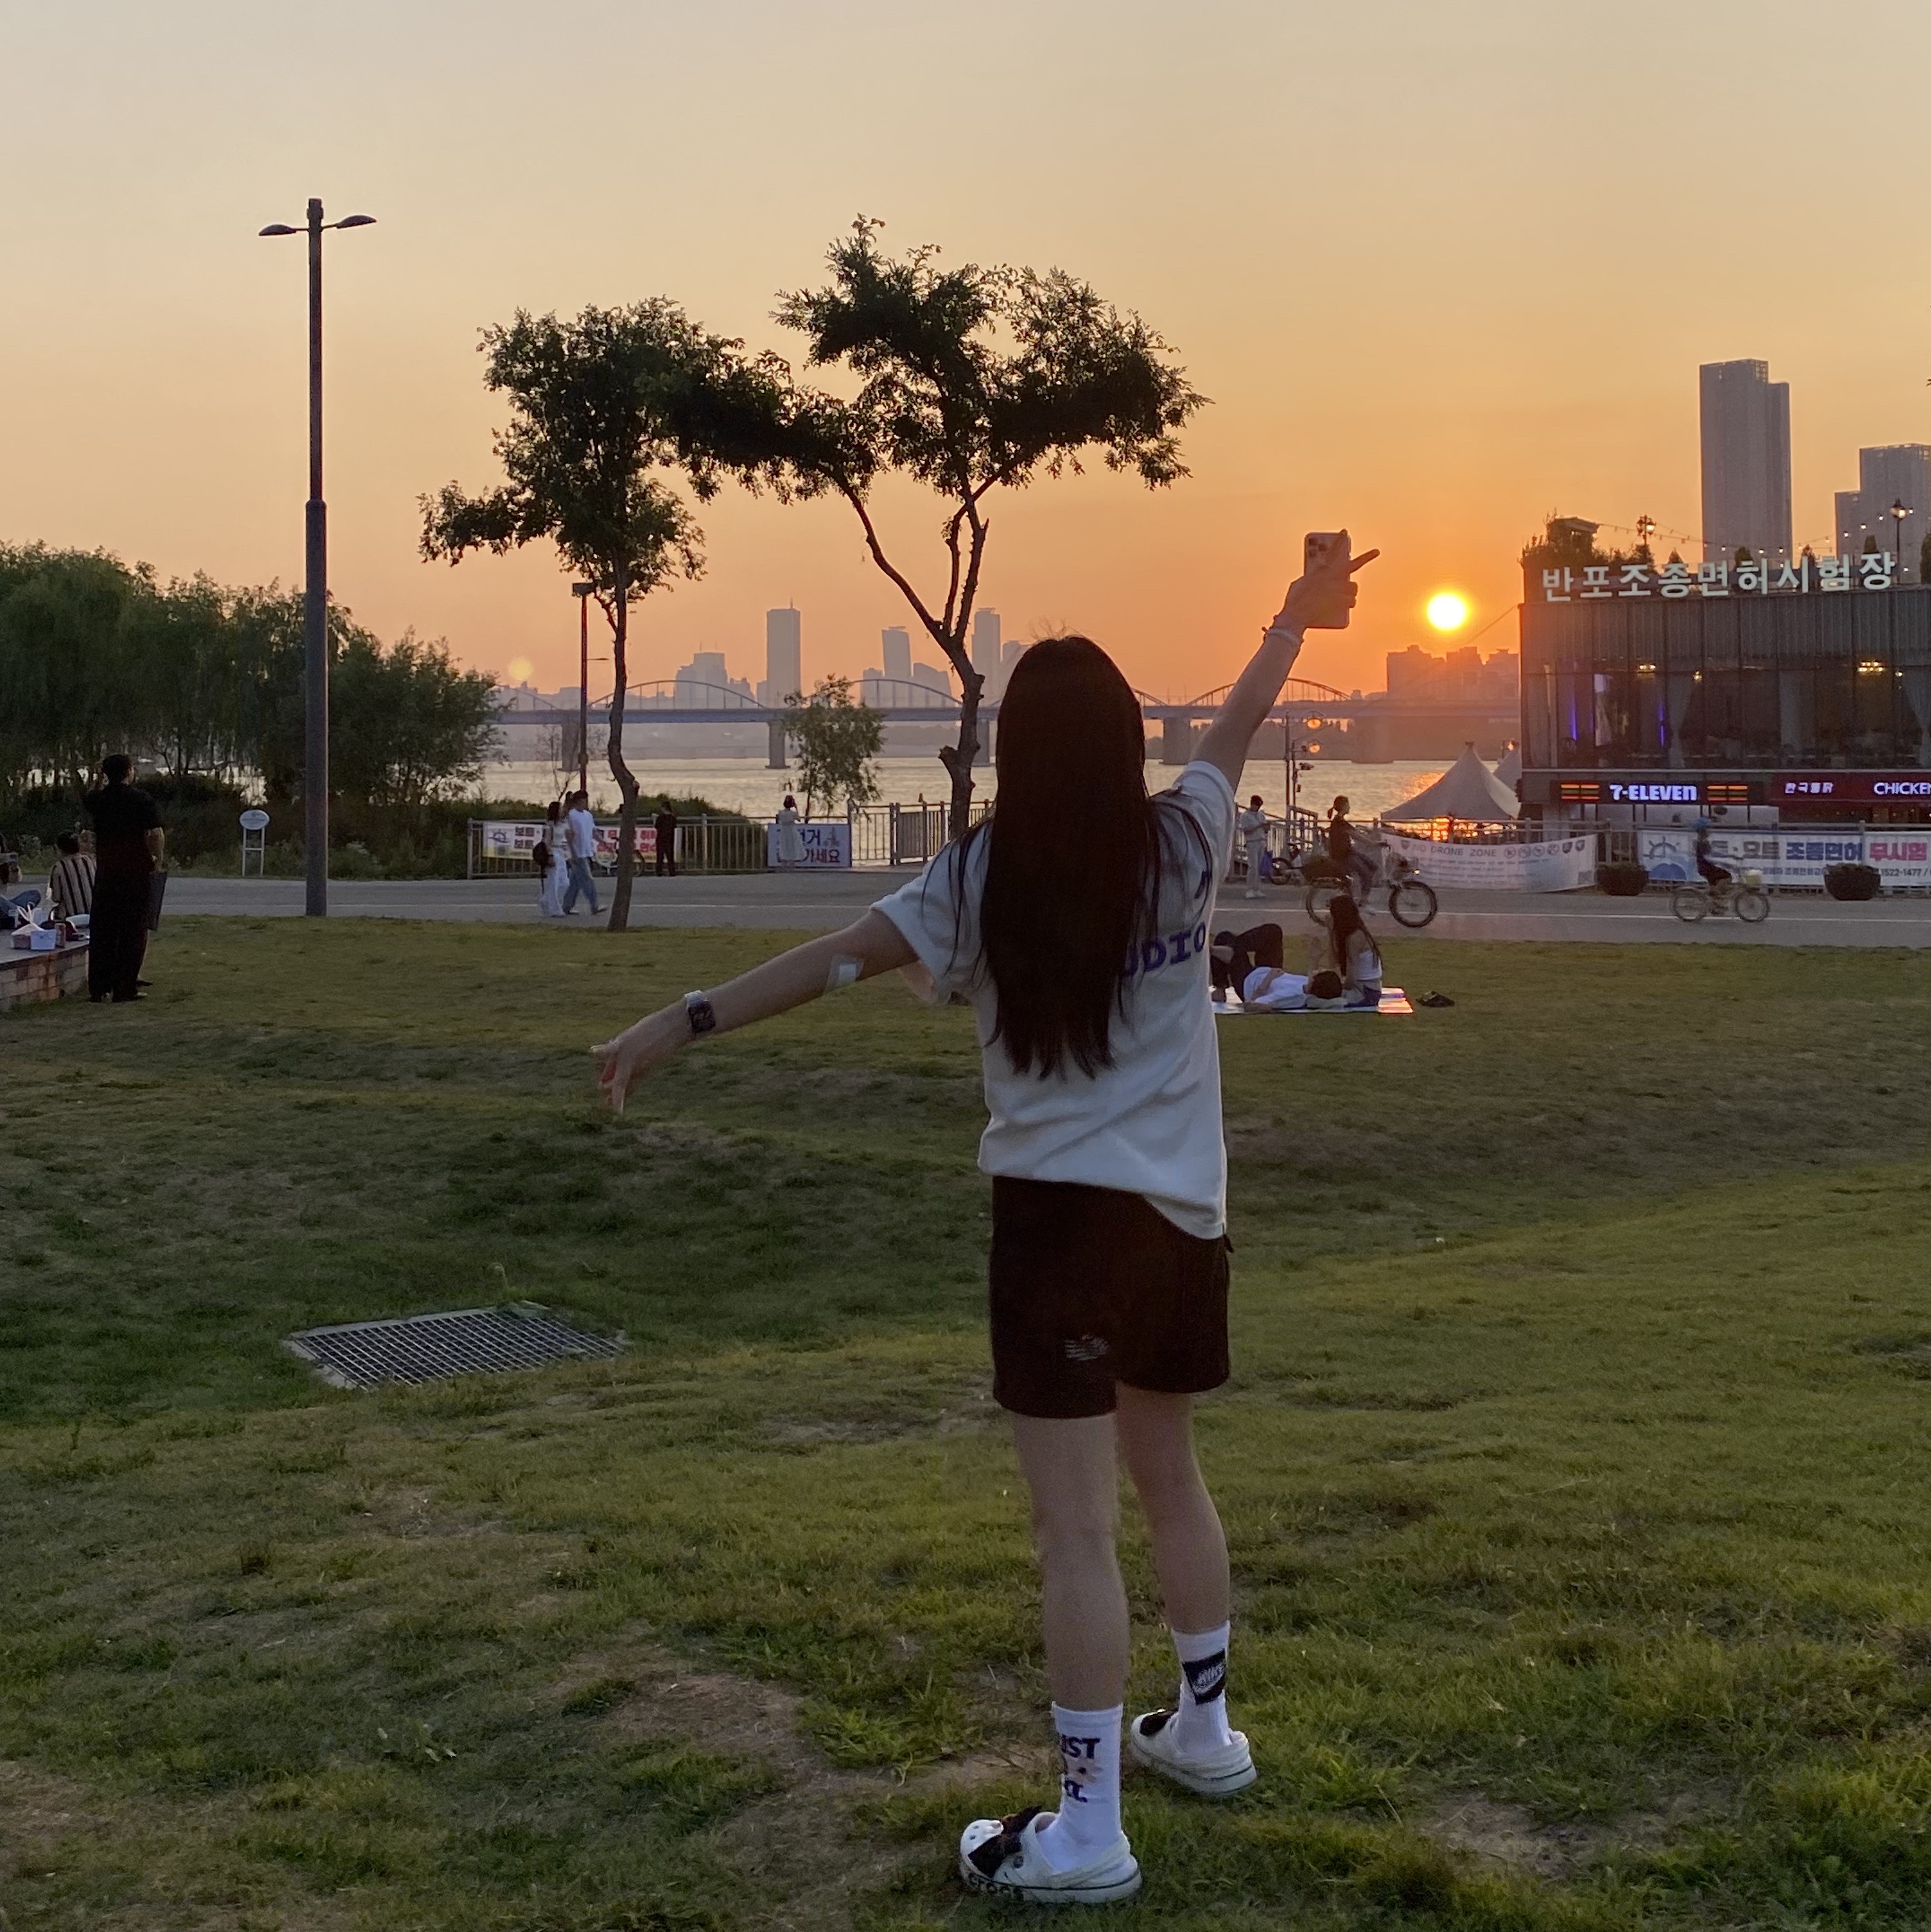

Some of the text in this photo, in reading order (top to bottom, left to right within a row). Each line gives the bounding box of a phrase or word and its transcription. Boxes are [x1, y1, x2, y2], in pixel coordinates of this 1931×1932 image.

[1543, 551, 1895, 602] 반포조종면허시험장
[1430, 846, 1464, 856] DRONE
[1470, 848, 1497, 857] ZONE
